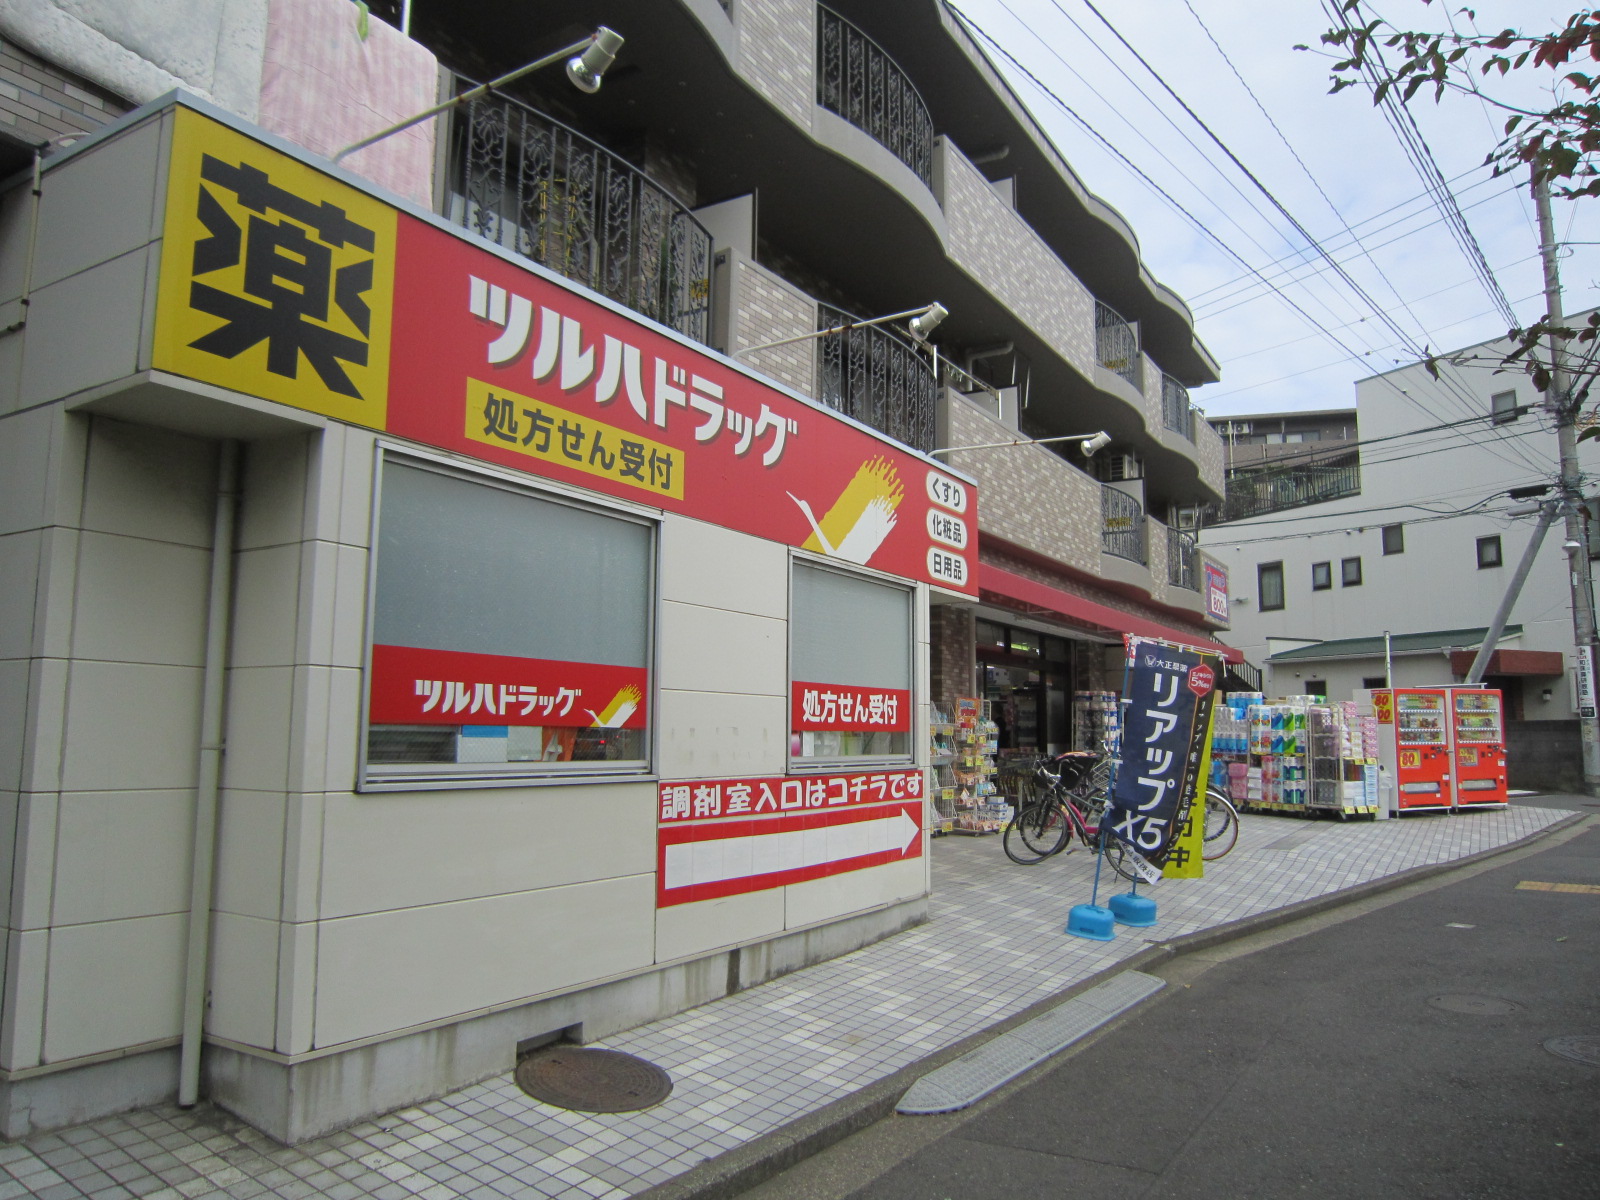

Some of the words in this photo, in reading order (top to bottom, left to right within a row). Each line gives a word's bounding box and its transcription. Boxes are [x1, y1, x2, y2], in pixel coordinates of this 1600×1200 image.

[187, 152, 375, 401] 薬
[469, 274, 798, 467] ツルハドラッグ
[483, 392, 673, 490] 処方せん受付
[932, 478, 961, 507] くすり
[932, 514, 962, 544] 化粧品
[933, 553, 962, 580] 日用品
[415, 679, 582, 717] ツルハドラッグ
[802, 688, 898, 725] 処方せん受付
[660, 772, 923, 820] 調剤室入口はコチラです
